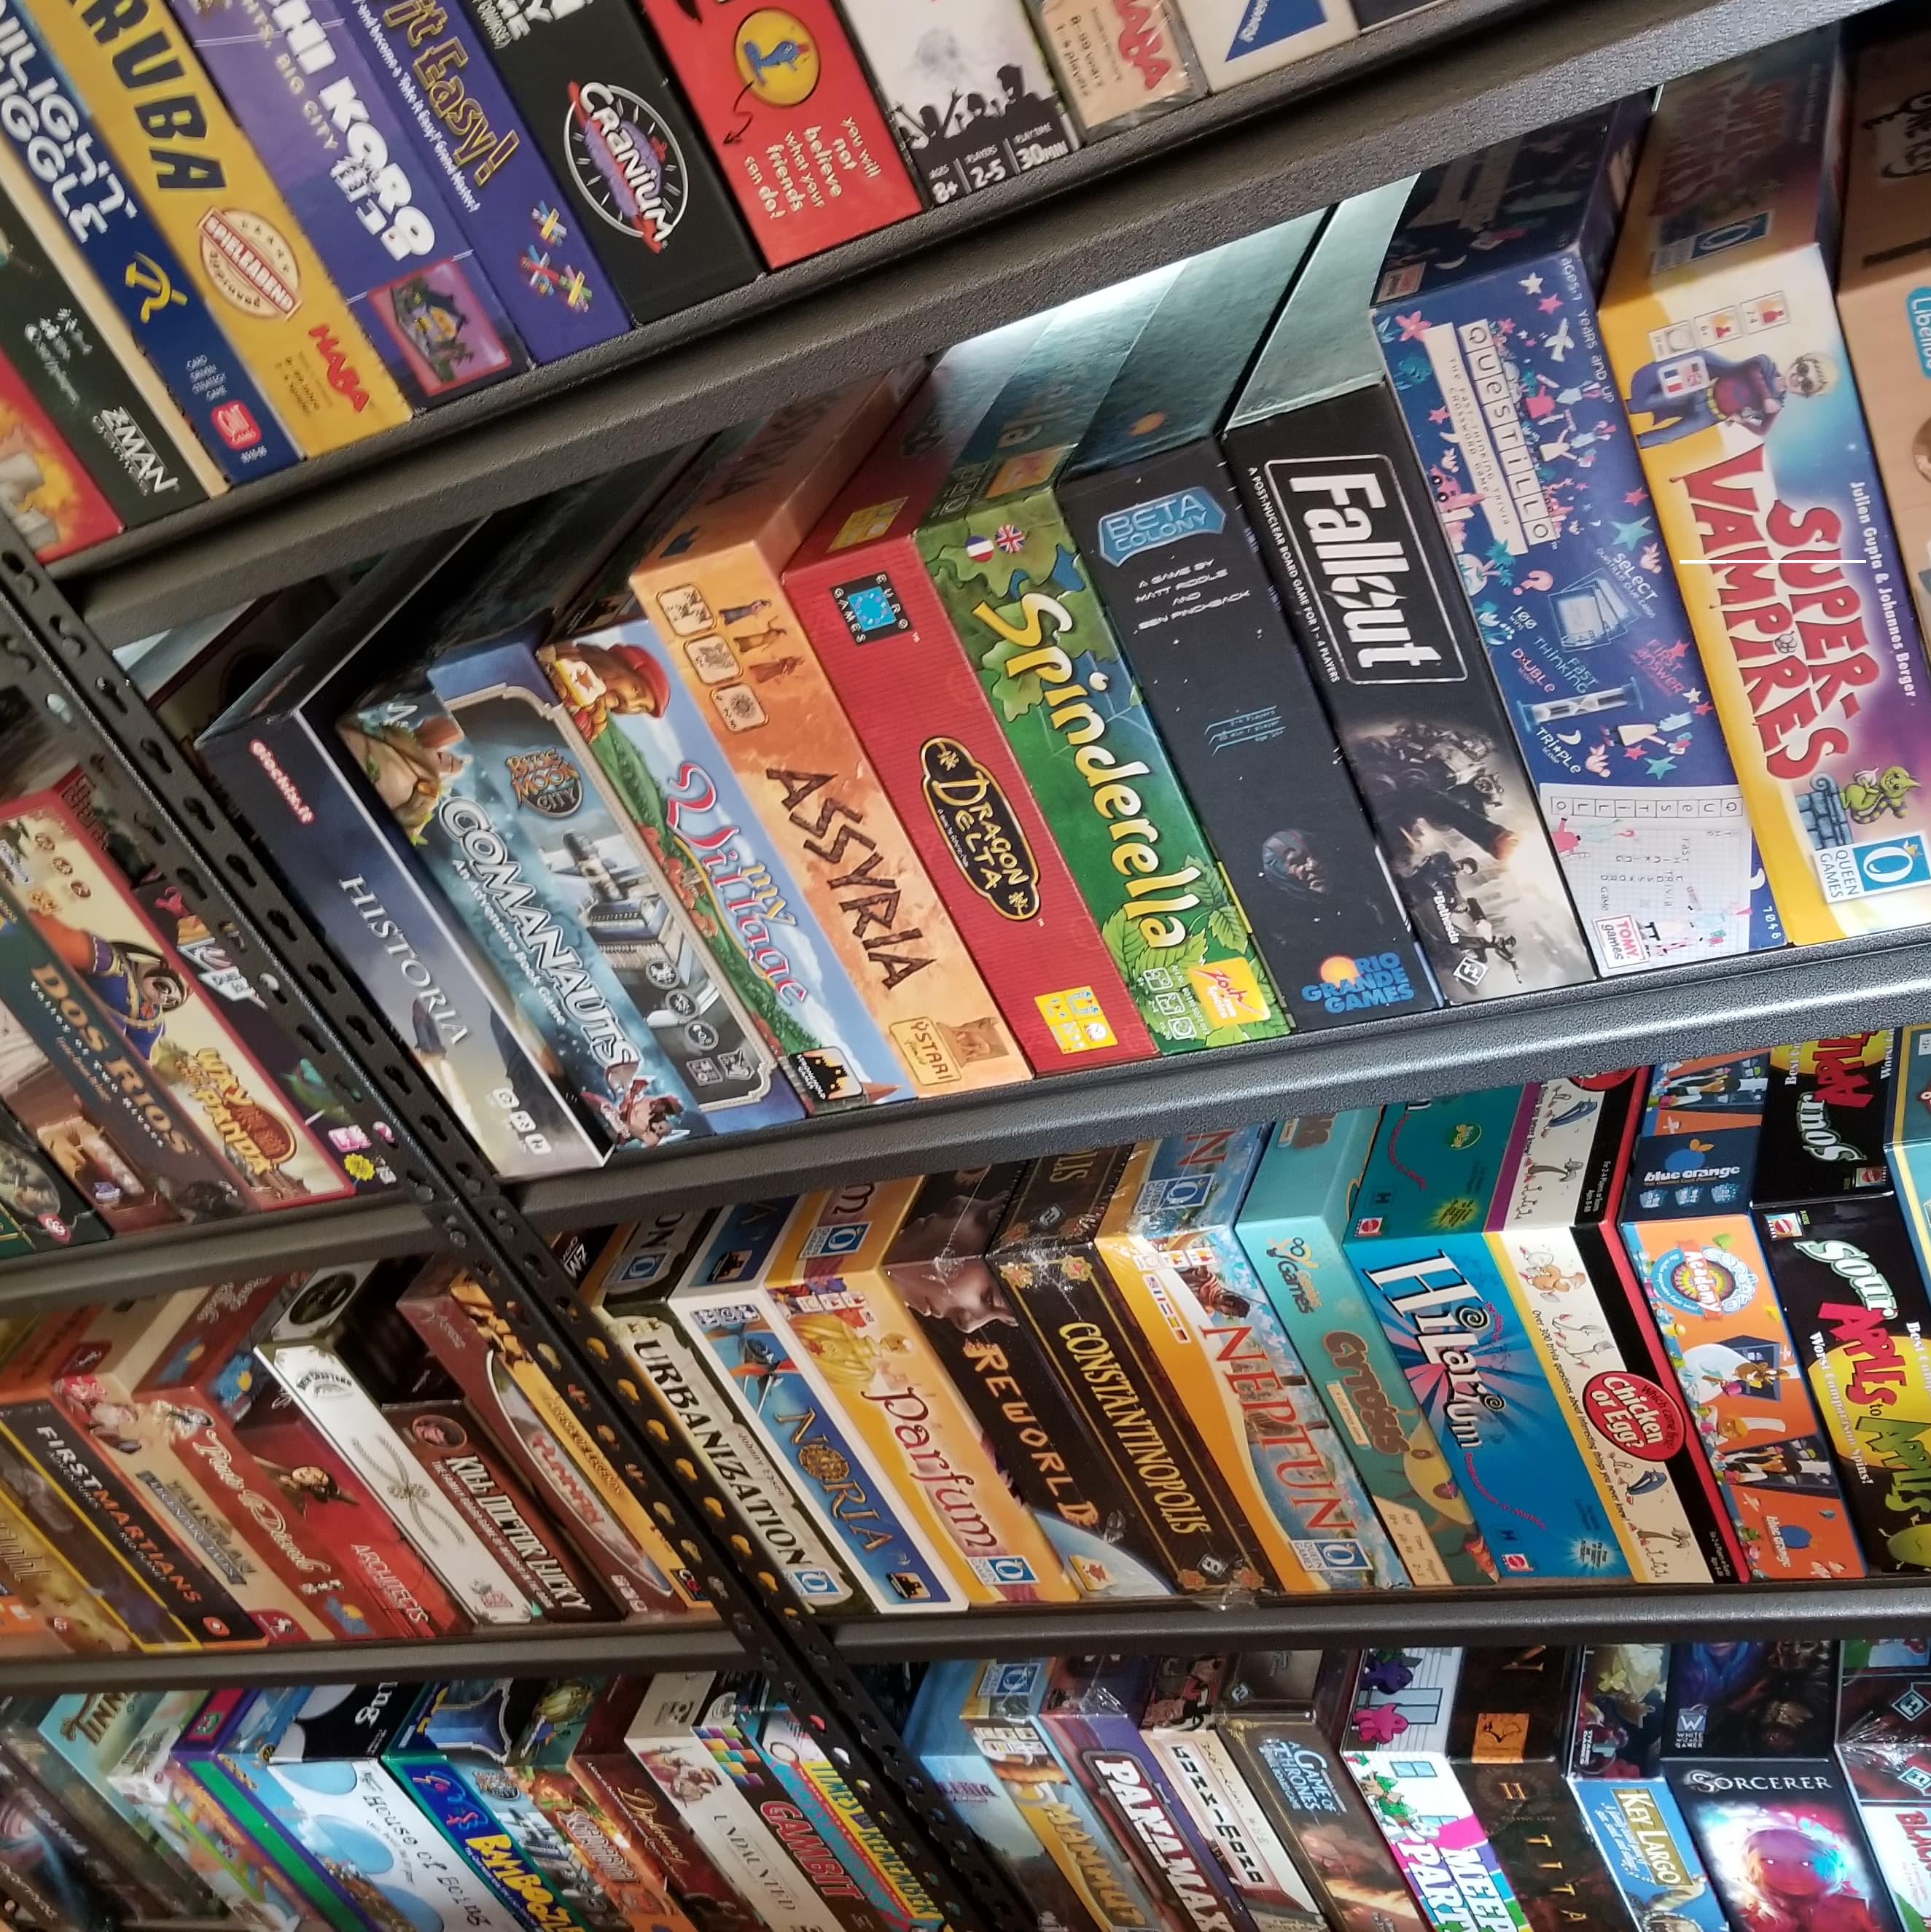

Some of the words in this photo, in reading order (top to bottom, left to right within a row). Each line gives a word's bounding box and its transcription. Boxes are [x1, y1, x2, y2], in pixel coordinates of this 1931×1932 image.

[68, 0, 227, 189] RUBA
[276, 52, 305, 95] BIG
[303, 101, 340, 150] CITY
[411, 36, 520, 187] Easy!
[784, 130, 810, 173] what
[800, 171, 826, 208] your
[804, 125, 843, 198] believe
[832, 138, 857, 171] not
[840, 116, 864, 148] you
[859, 148, 881, 179] will
[744, 155, 762, 185] can
[759, 184, 786, 219] do!
[766, 144, 805, 214] friends
[931, 180, 959, 204] 8+
[969, 158, 1007, 189] 2-5
[1248, 467, 1258, 477] A
[1104, 494, 1206, 540] BETA
[1112, 512, 1209, 552] COLONY
[1252, 475, 1285, 547] POST-NUCLEAR
[1151, 564, 1192, 586] GAME
[1193, 558, 1216, 572] BY
[1279, 544, 1299, 579] BOARD
[1287, 472, 1443, 669] Fallout
[1134, 585, 1171, 604] MATT
[1136, 615, 1169, 631] BEN
[1170, 589, 1251, 621] PINCHBACK
[1171, 591, 1201, 607] AND
[1292, 577, 1311, 607] GAME
[1303, 605, 1318, 627] FOR
[1669, 443, 1849, 780] VAMPIRES
[1849, 481, 1871, 523] Julien
[1862, 526, 1883, 577] Gupta
[1878, 582, 1904, 652] Johannes
[1896, 652, 1917, 698] Berger
[1319, 646, 1341, 683] PLAYERS
[514, 760, 581, 801] MOON
[972, 593, 1202, 949] Spinderella
[537, 787, 577, 812] CITY
[666, 763, 808, 1008] Village
[742, 861, 797, 927] My
[1819, 852, 1844, 899] GAMES
[1835, 849, 1860, 897] QUEEN
[338, 873, 472, 1045] HISTORIA
[440, 796, 641, 1069] COMANAUTS
[459, 875, 523, 954] Adventure
[511, 949, 543, 986] Book
[534, 983, 571, 1027] Game
[1600, 923, 1624, 962] games
[1300, 968, 1407, 1002] GRANDE
[1354, 951, 1402, 973] RIO
[1323, 983, 1415, 1014] GAMES
[1643, 1168, 1681, 1183] blue
[1681, 1166, 1741, 1180] orange
[1275, 1261, 1315, 1314] Games
[1684, 1250, 1723, 1314] Academy
[1792, 1239, 1899, 1320] Sour
[1532, 1309, 1546, 1328] Over
[1540, 1325, 1553, 1342] 300
[1905, 1320, 1926, 1355] Best
[1546, 1341, 1559, 1362] trivia
[1553, 1360, 1575, 1398] questions
[1569, 1395, 1584, 1416] about
[963, 1339, 1101, 1530] REWORLD
[1058, 1321, 1213, 1535] CONSTANTINOPOLIS
[1198, 1324, 1355, 1530] NEPTUN
[1578, 1412, 1597, 1451] interesting
[1590, 1389, 1618, 1409] or
[1604, 1409, 1645, 1449] Egg?
[1603, 1376, 1664, 1444] Chicken
[1869, 1403, 1883, 1417] to
[633, 1337, 814, 1569] URBANIZATION
[860, 1385, 999, 1550] Parfum
[774, 1406, 894, 1554] NORIA
[36, 1426, 103, 1490] FIRST
[92, 1487, 203, 1603] MARTIANS
[1276, 1742, 1322, 1813] THRONES
[1293, 1749, 1335, 1801] GAME
[1684, 1768, 1833, 1793] SORCERER
[759, 1800, 865, 1902] GAMBIT
[1618, 1791, 1653, 1828] KEY
[1637, 1830, 1682, 1886] LARGO
